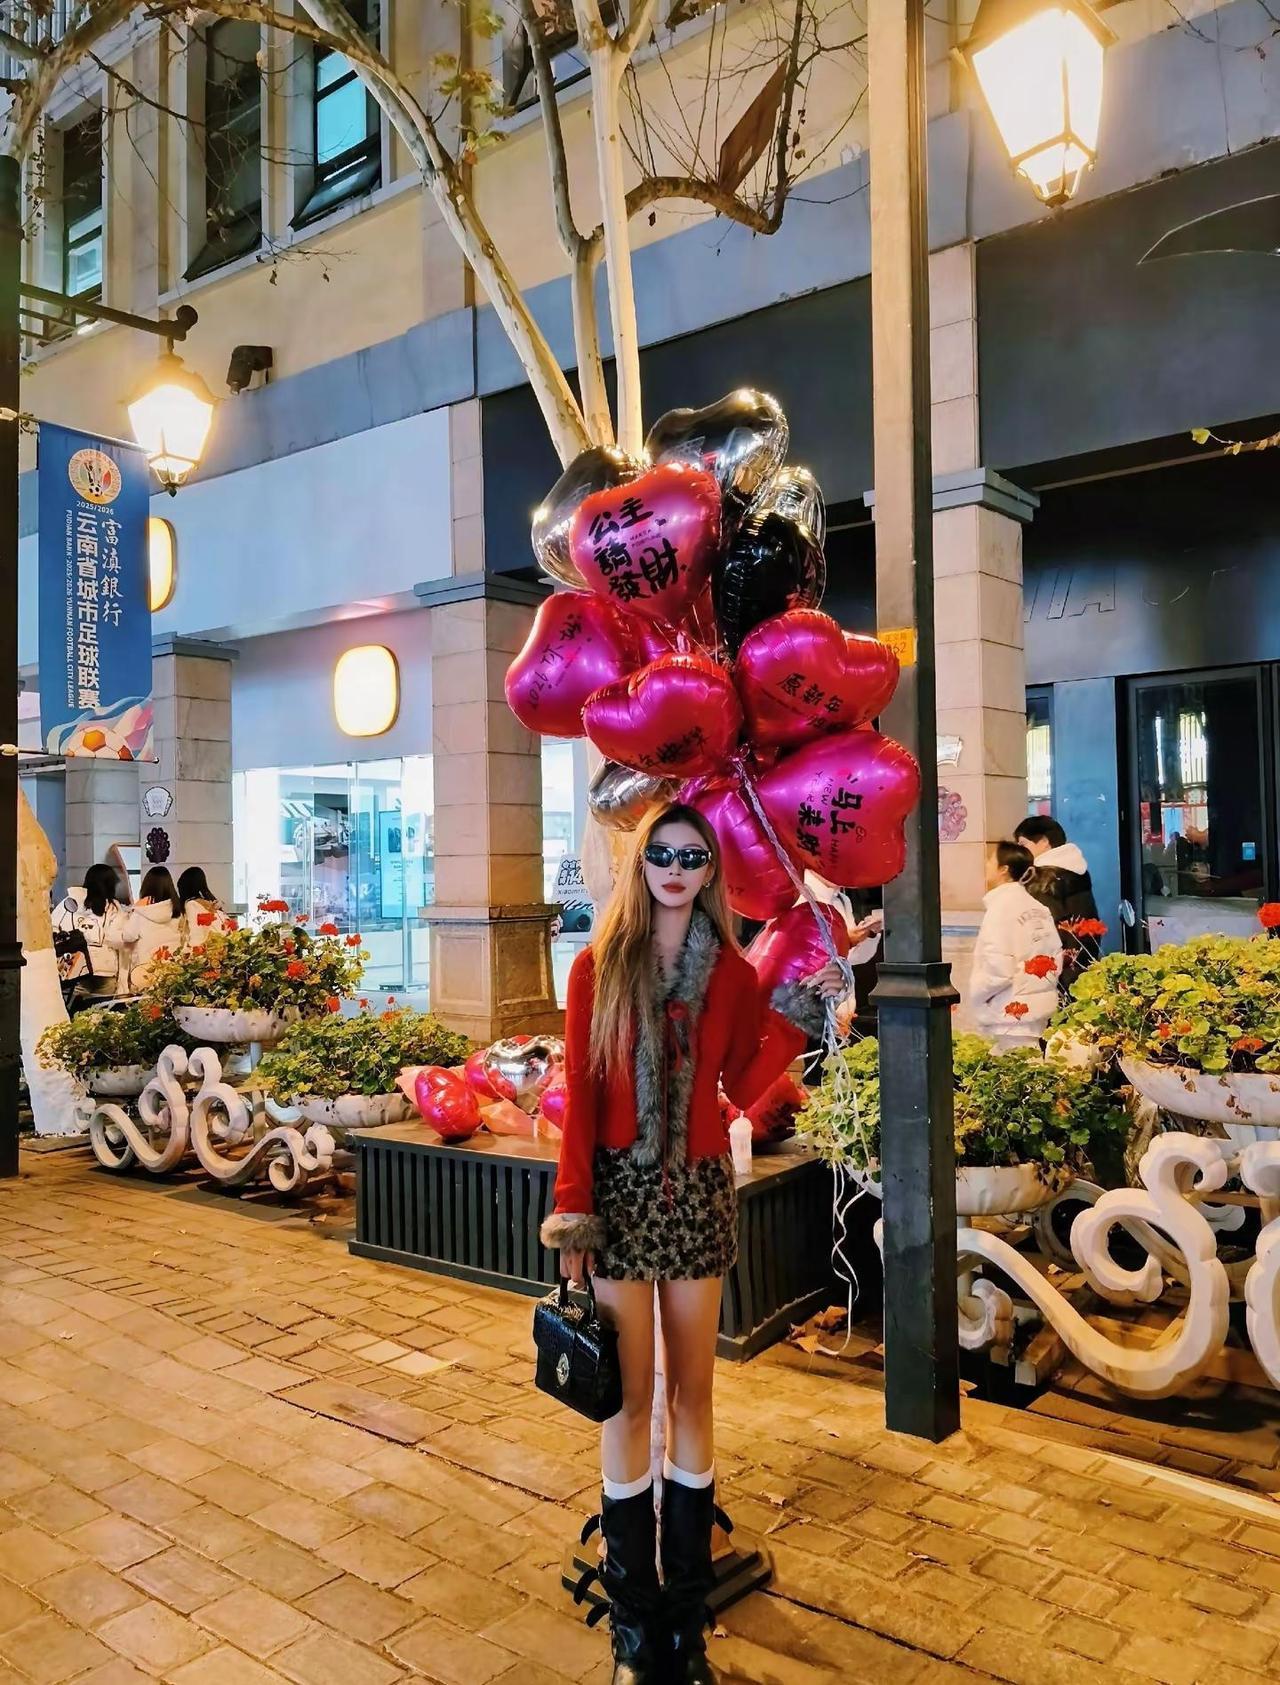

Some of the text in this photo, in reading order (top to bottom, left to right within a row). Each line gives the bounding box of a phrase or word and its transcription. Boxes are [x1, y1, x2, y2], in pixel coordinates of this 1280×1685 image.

[76, 500, 115, 516] 2025/2026
[588, 497, 654, 545] 公主
[65, 509, 73, 536] FUDIAN
[65, 597, 74, 625] YUNNAN
[76, 511, 101, 711] 云南省城市足球联赛
[66, 626, 74, 663] FOOTBALL
[66, 664, 74, 680] CITY
[67, 680, 75, 708] LEAGUE
